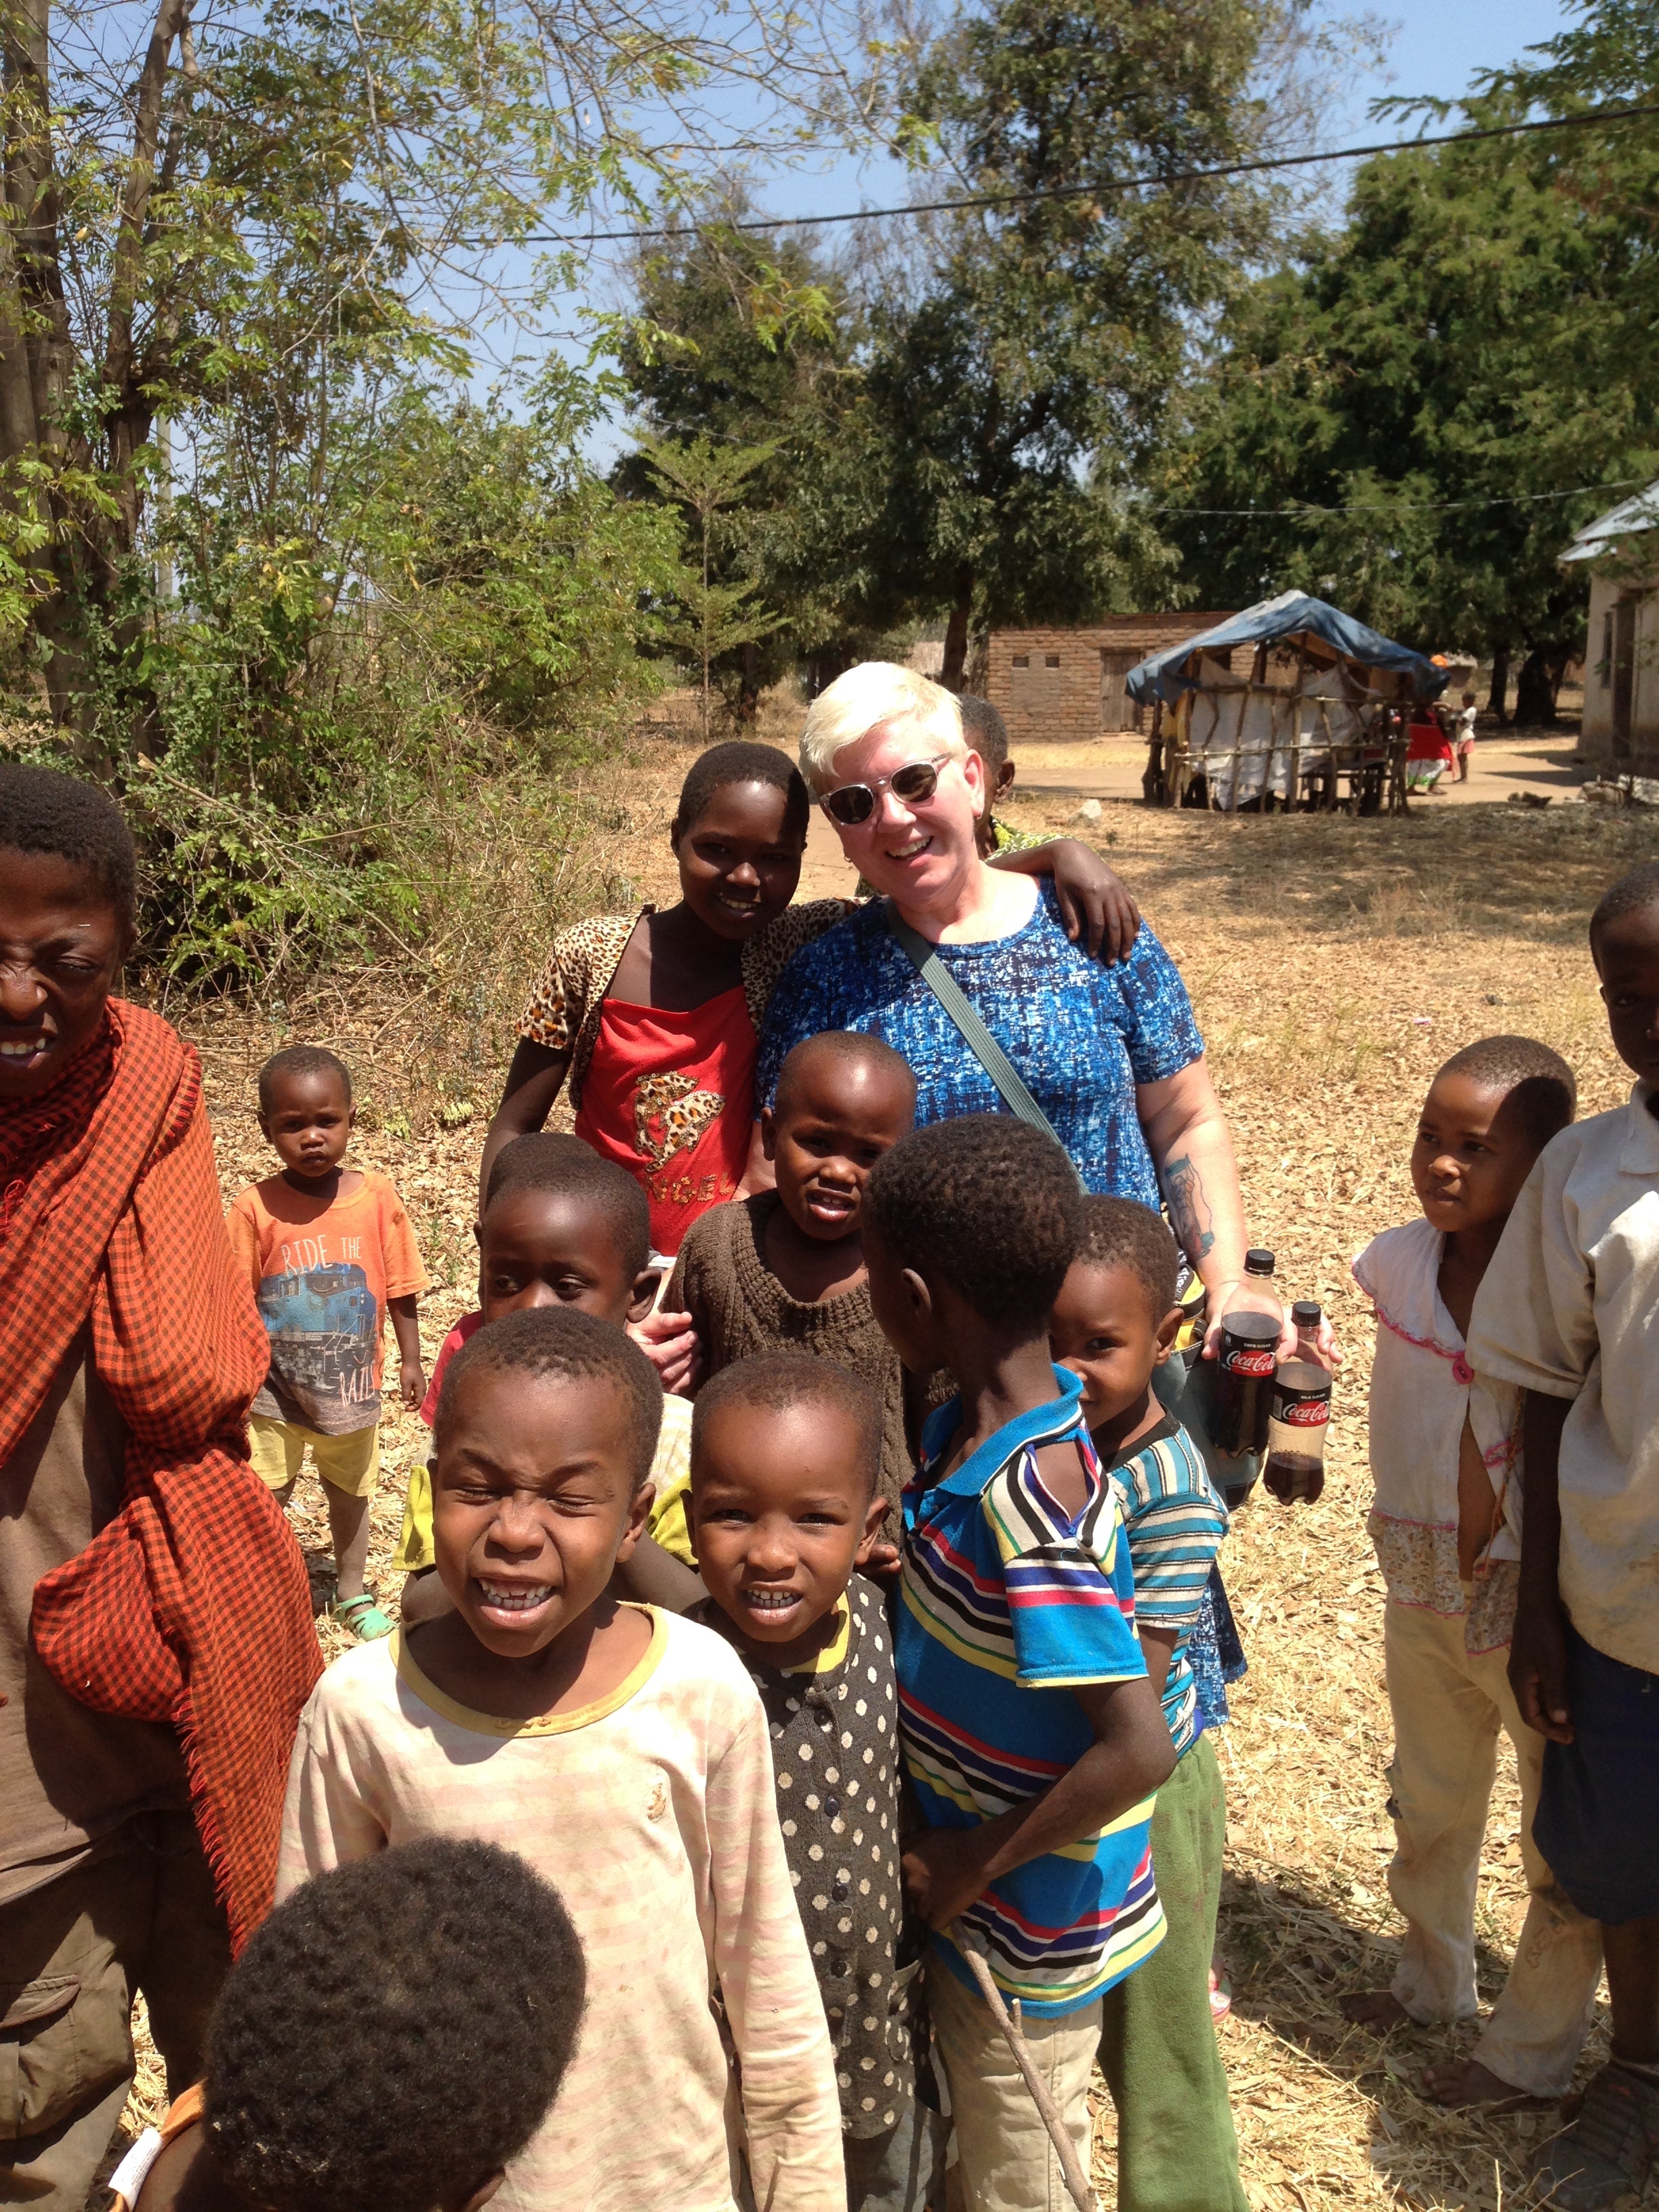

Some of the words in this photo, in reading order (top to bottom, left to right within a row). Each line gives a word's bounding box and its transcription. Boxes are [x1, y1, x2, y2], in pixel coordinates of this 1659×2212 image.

[646, 1172, 735, 1204] NGEL
[281, 1234, 333, 1277] RIDE
[340, 1236, 362, 1259] THE
